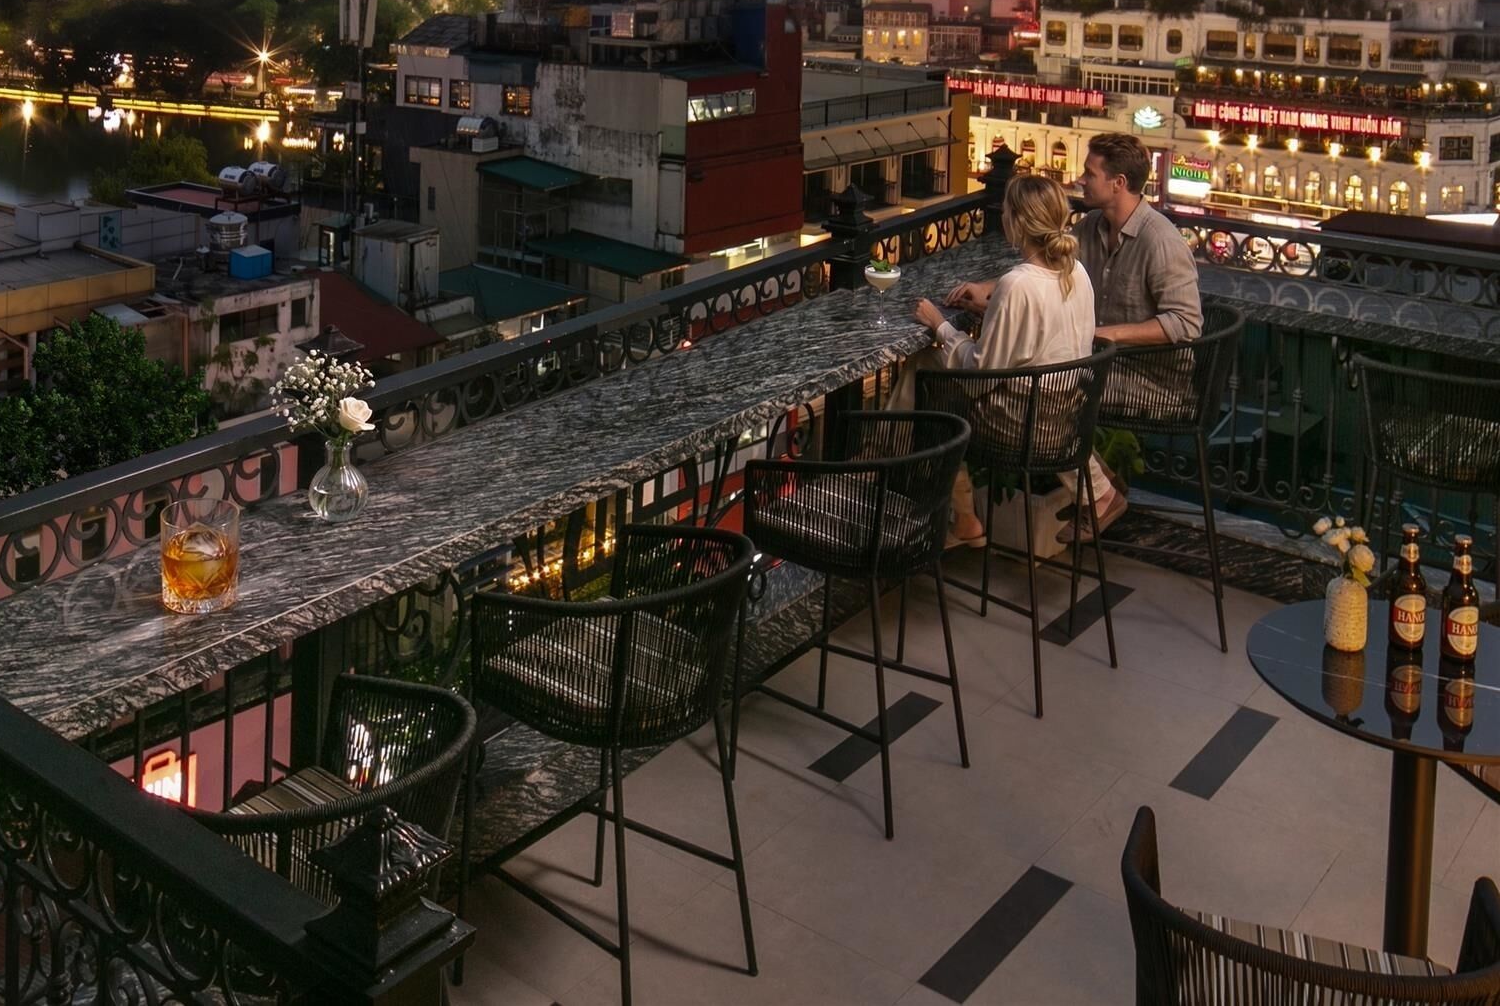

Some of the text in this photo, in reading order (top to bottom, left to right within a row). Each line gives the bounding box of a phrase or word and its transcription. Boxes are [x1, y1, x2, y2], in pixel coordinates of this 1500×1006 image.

[973, 79, 983, 95] XÃ
[983, 79, 995, 98] HỘI
[1031, 84, 1045, 103] VIỆT
[1046, 89, 1062, 103] NAM
[1064, 87, 1086, 105] MUÔN
[1087, 90, 1104, 107] NĂM
[1218, 101, 1240, 122] CỘNG
[1242, 103, 1260, 122] SẢN
[1260, 106, 1279, 126] VIỆT
[1279, 110, 1299, 126] NAM
[1300, 112, 1329, 130] QUANG
[1331, 115, 1351, 131] VINH
[1352, 115, 1379, 134] MUÔN
[1380, 117, 1402, 136] NĂM
